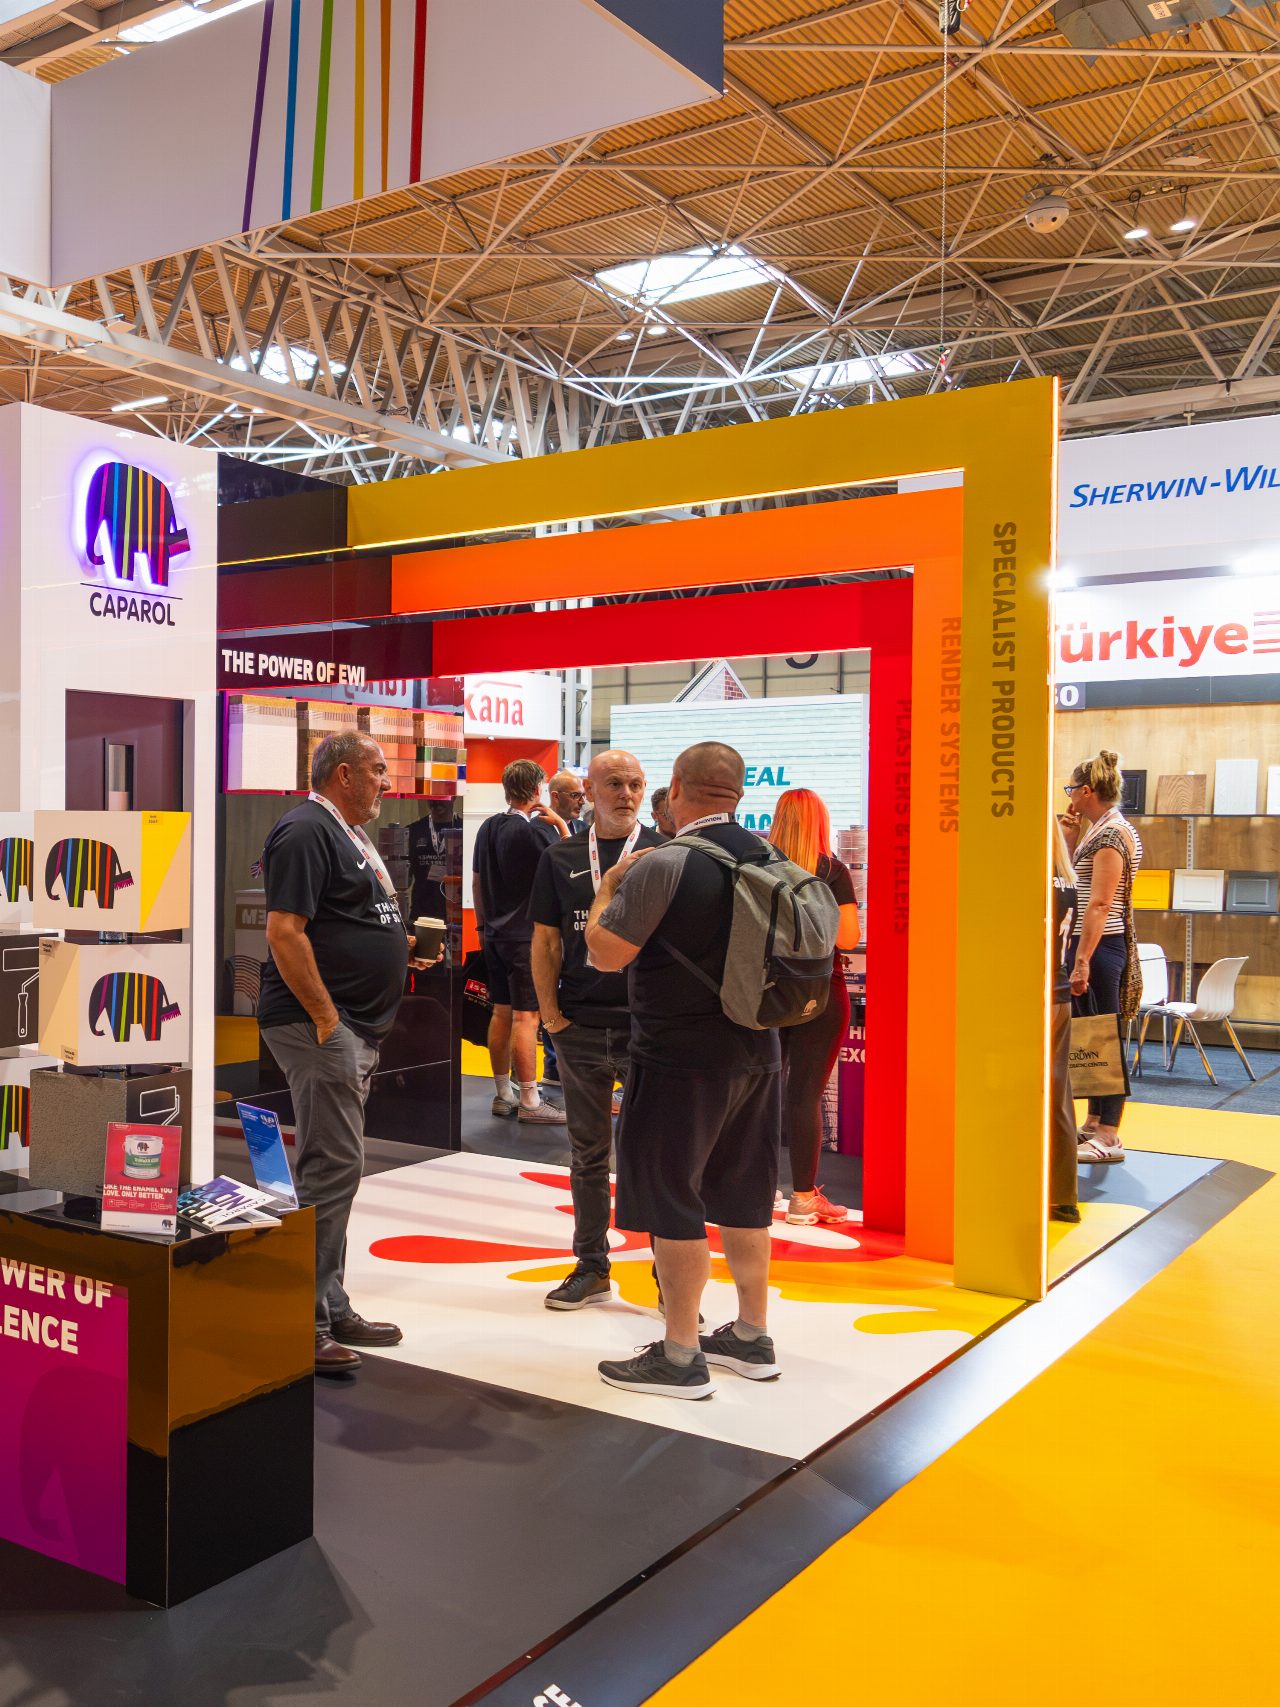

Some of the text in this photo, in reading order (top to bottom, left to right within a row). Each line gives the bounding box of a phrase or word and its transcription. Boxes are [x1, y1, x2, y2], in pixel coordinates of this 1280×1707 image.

[89, 591, 176, 627] CAPAROL
[1056, 615, 1248, 667] ürkiye
[222, 649, 365, 687] THE POWER OF EWI
[991, 521, 1017, 818] SPECIALIST PRODUCTS
[939, 616, 962, 834] RENDER SYSTEMS
[574, 910, 589, 920] TH
[103, 1189, 165, 1200] LOVE. ONLY BETTER.
[74, 1274, 114, 1309] OF
